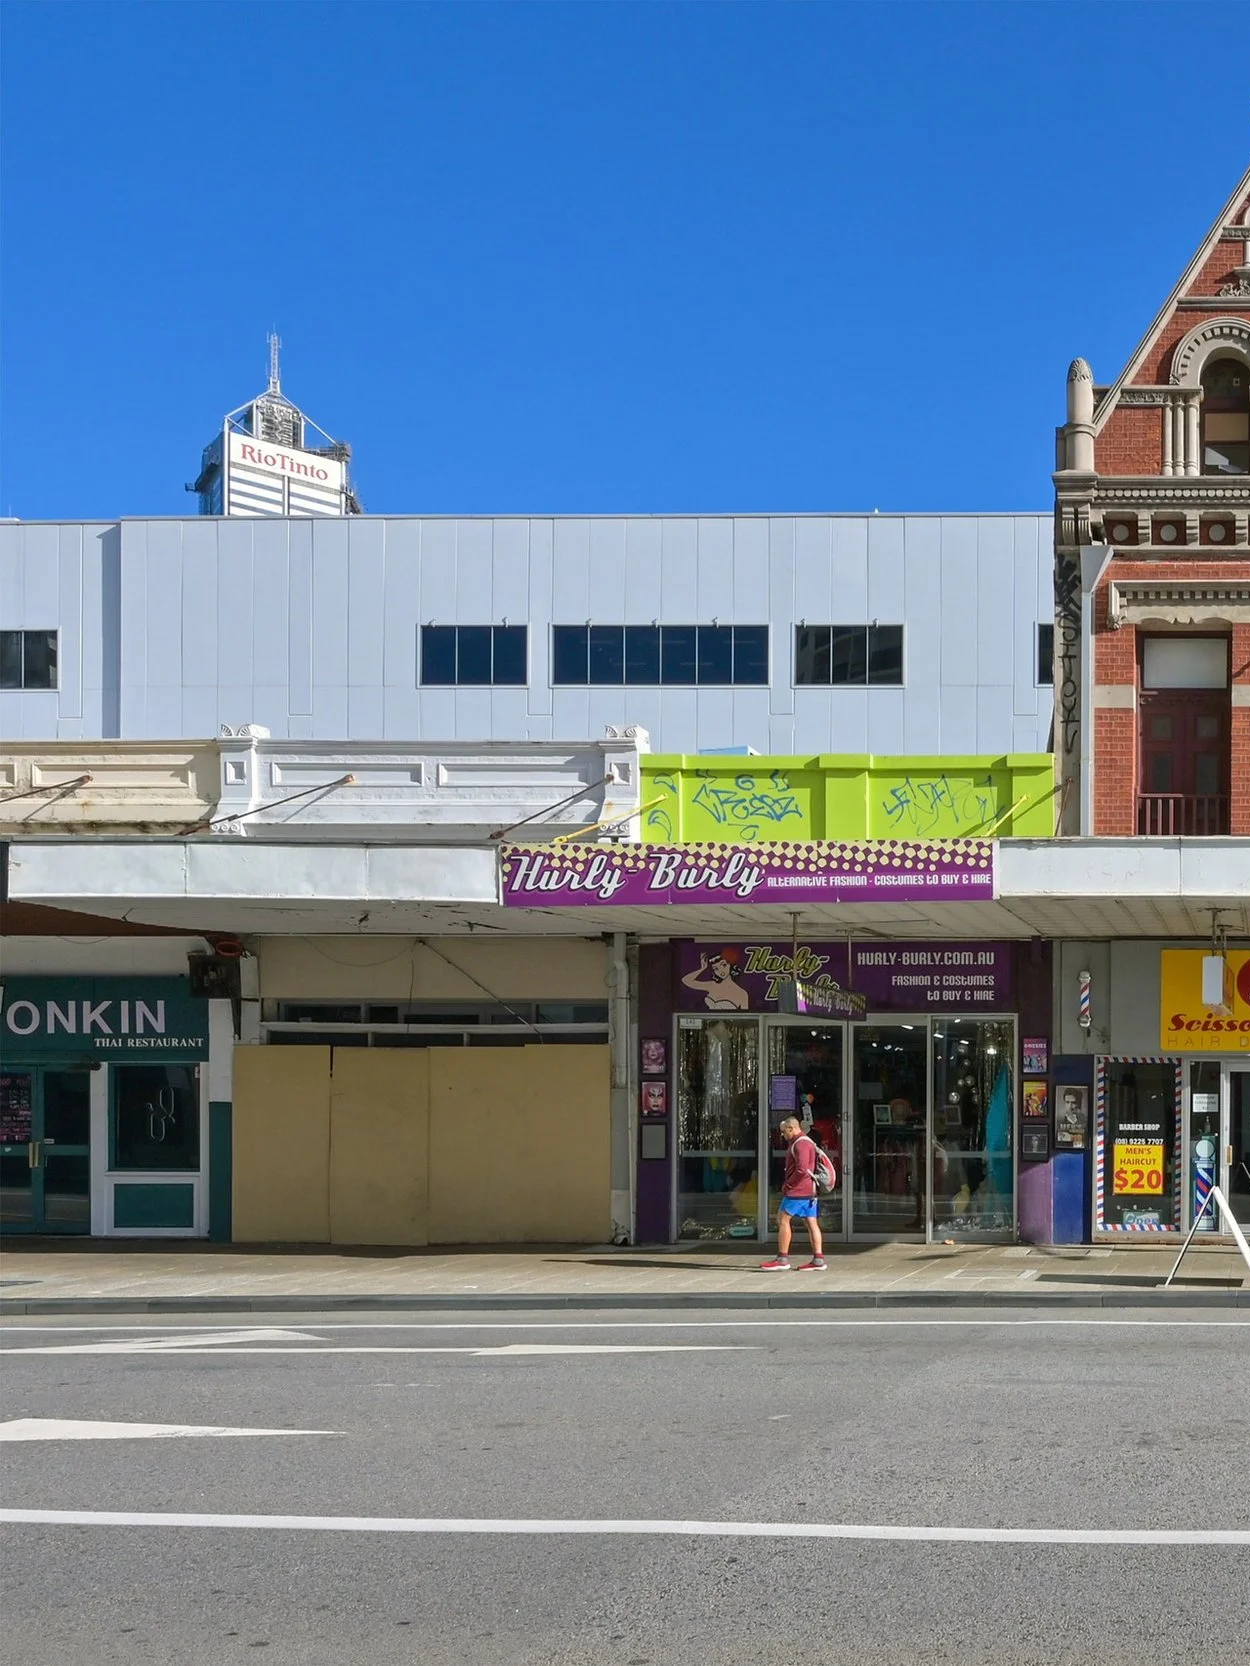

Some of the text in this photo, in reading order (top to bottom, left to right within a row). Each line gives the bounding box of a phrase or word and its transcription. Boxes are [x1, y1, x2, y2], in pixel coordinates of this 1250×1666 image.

[941, 874, 959, 885] BUY
[962, 874, 969, 884] &
[971, 873, 991, 885] HIRE
[857, 952, 995, 966] HURLY-BURLY.COM.AU
[892, 975, 931, 986] FASHION
[934, 975, 940, 986] &
[942, 990, 958, 1001] BUY
[961, 989, 969, 1001] &
[974, 989, 994, 1001] HIRE
[94, 1038, 204, 1047] THAI RESTAURANT
[1168, 1036, 1221, 1047] HAIR
[1115, 1168, 1162, 1190] $20
